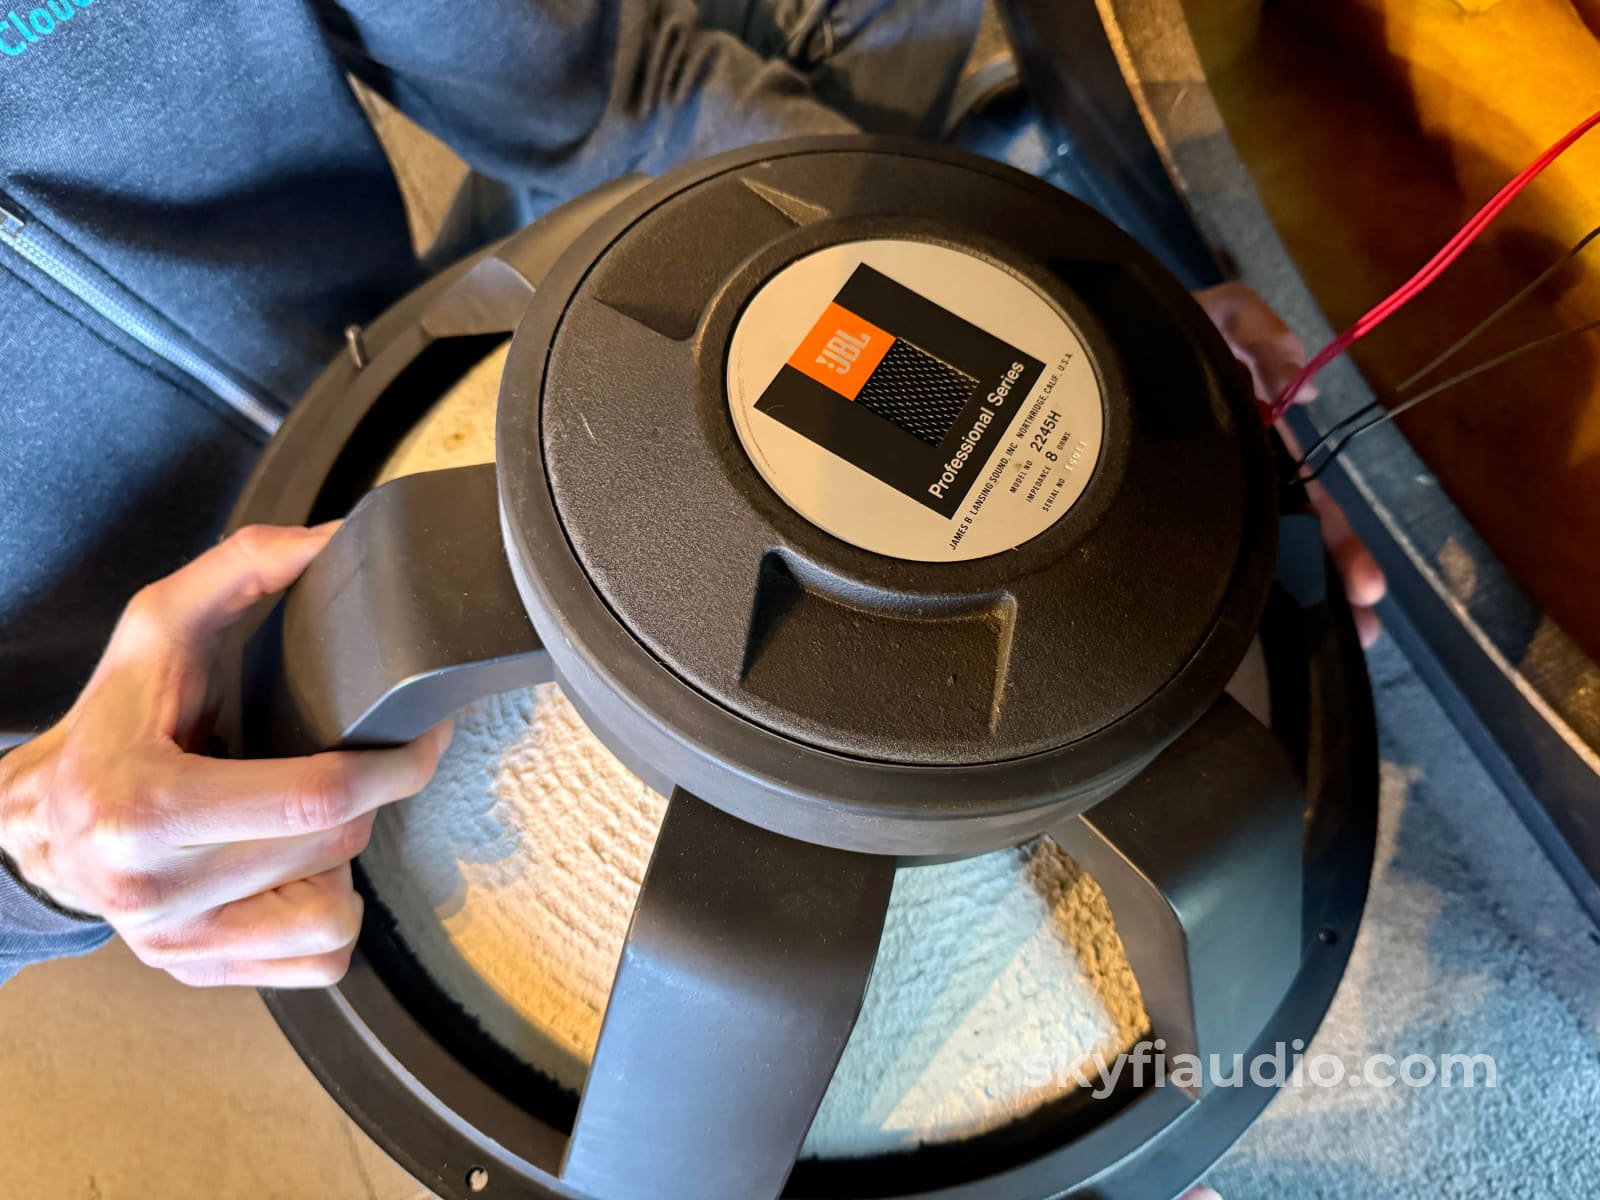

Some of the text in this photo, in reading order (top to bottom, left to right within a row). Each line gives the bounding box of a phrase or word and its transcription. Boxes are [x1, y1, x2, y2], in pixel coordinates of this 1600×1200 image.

[0, 0, 94, 56] Clou
[820, 329, 871, 375] JBL
[928, 361, 1024, 499] Professional Series
[1009, 471, 1027, 494] MODEL
[1030, 410, 1062, 452] 2245H
[1025, 431, 1071, 502] IMPEDANCE 8 OHMS
[949, 523, 969, 550] JAMES
[969, 482, 994, 515] LANSING
[1042, 490, 1060, 512] SERIAL
